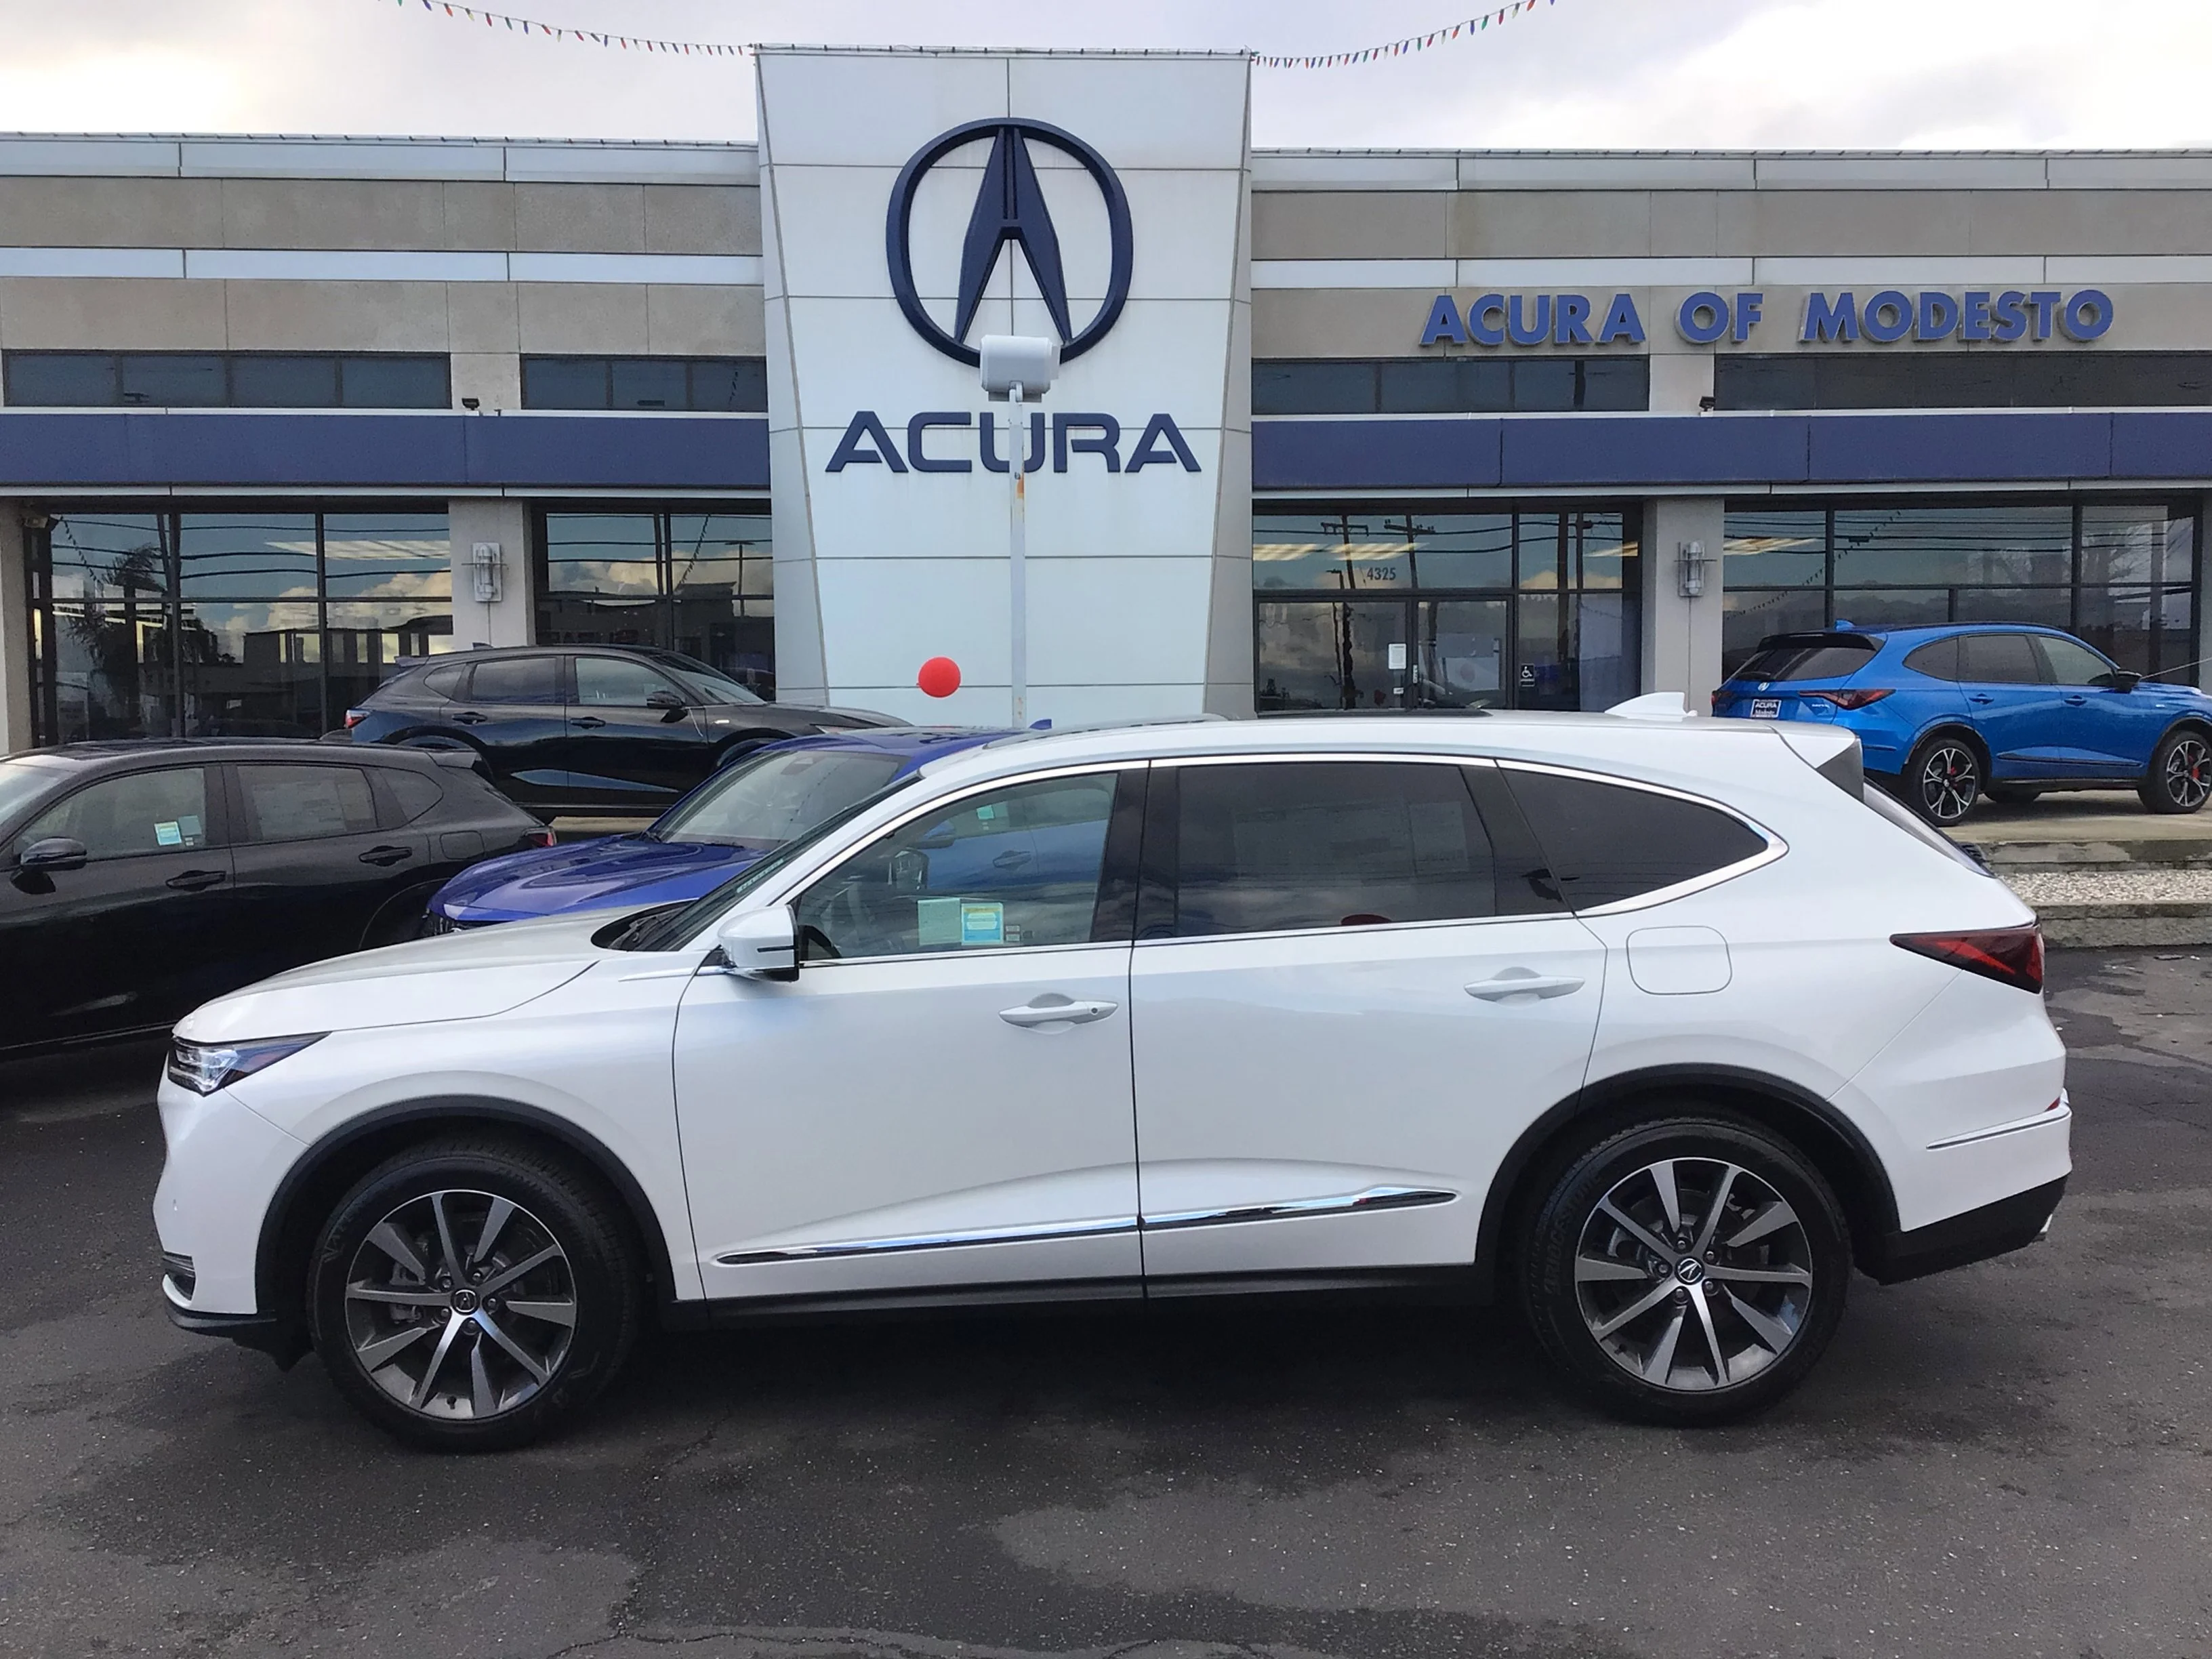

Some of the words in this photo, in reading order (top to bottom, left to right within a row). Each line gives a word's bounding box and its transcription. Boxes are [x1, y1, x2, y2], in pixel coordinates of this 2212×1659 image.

[1420, 293, 1645, 345] ACURA
[1679, 291, 1763, 344] OF
[1803, 289, 2114, 343] MODESTO
[825, 411, 1202, 473] ACURA
[1367, 567, 1396, 580] 4325
